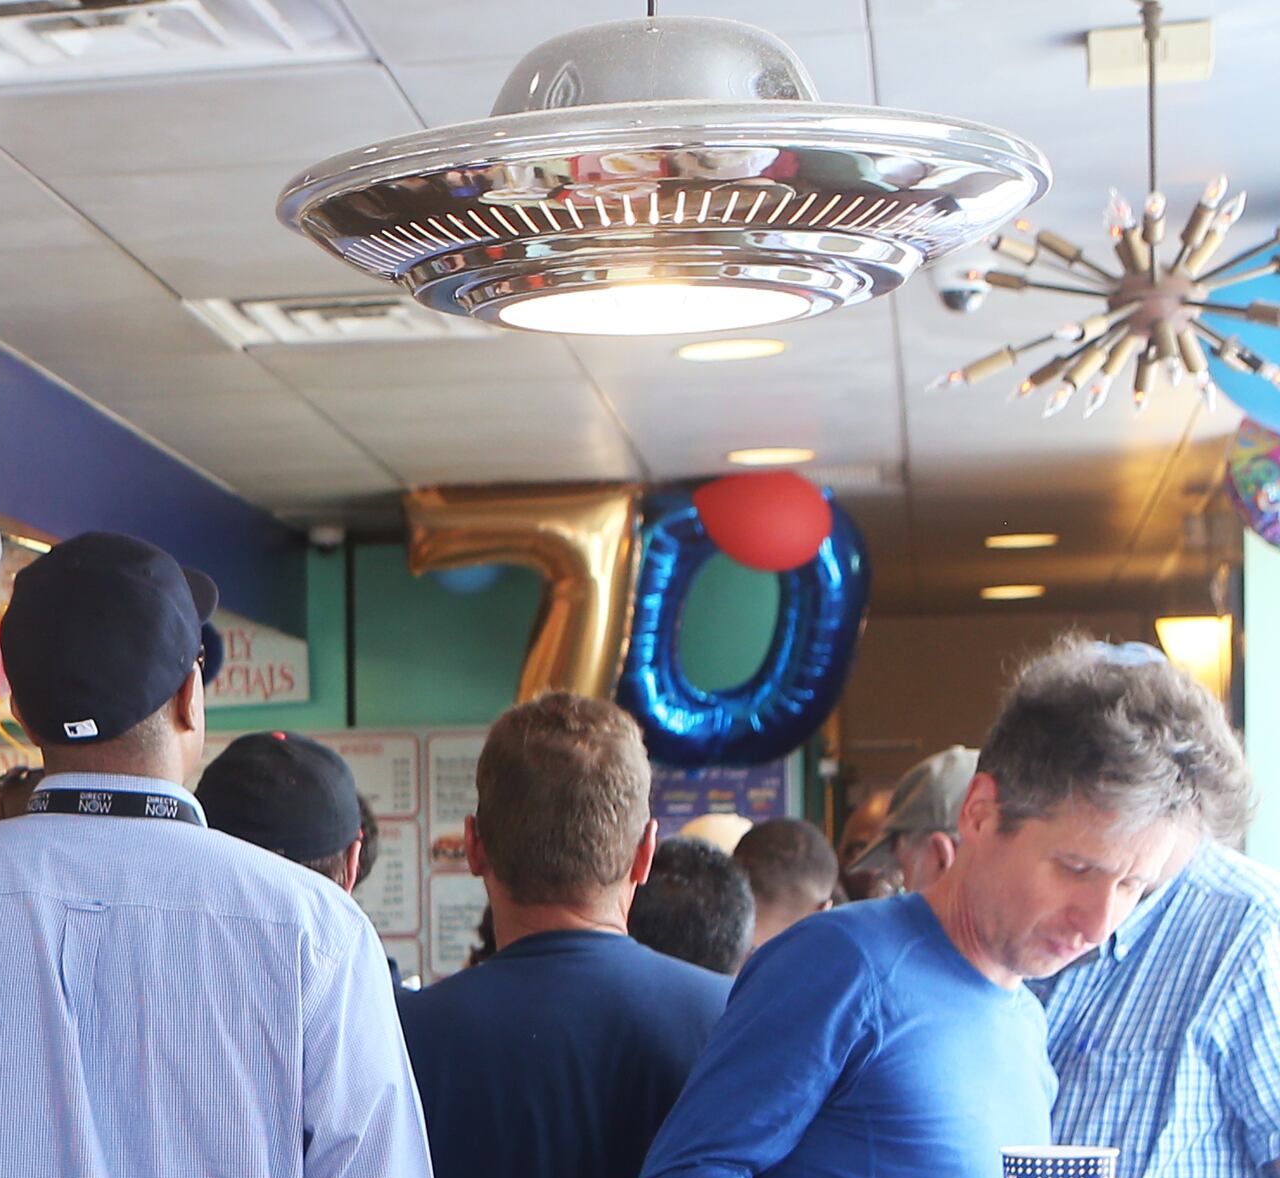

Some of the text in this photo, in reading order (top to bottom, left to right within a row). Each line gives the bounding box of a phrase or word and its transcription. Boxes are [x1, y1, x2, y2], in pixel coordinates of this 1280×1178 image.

[79, 792, 113, 801] DIRECTV
[146, 796, 178, 806] DIRECTV
[78, 801, 112, 814] NOW
[145, 803, 178, 818] NOW
